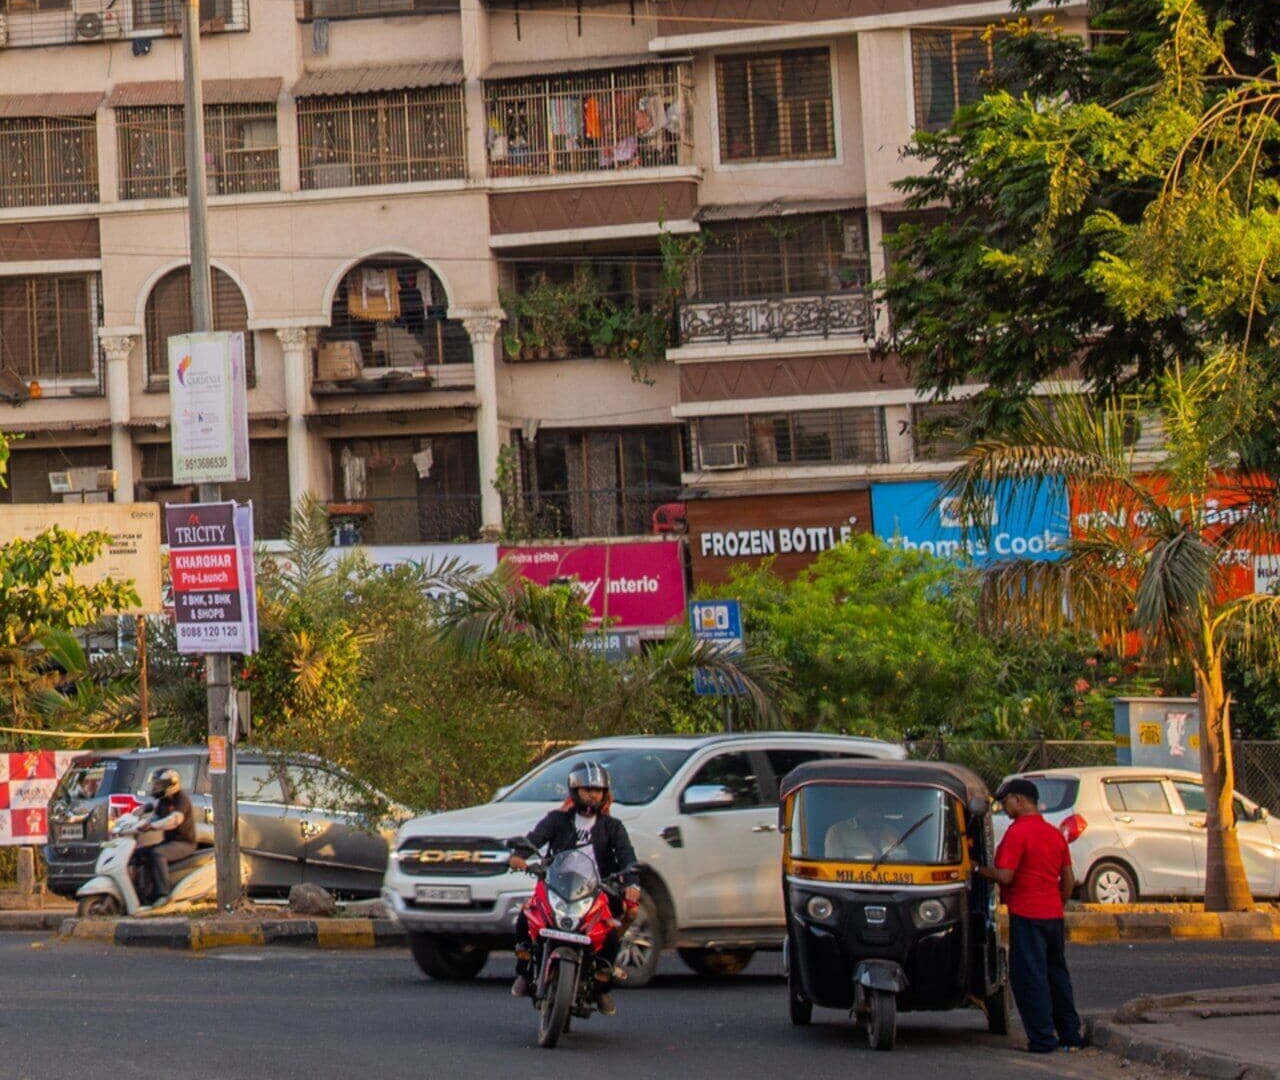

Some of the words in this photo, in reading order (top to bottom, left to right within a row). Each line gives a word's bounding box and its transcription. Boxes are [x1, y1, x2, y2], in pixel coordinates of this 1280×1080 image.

[175, 525, 226, 544] TRICITY
[701, 529, 776, 557] FROZEN
[994, 529, 1058, 555] Cook
[175, 554, 232, 569] KHARGHAR
[181, 571, 229, 584] Pre-Launch
[182, 595, 187, 606] 2
[188, 594, 208, 607] BHK,
[208, 594, 213, 605] 3
[214, 593, 231, 605] BHK
[190, 609, 196, 620] &
[197, 608, 225, 620] SHOPS
[181, 627, 202, 638] 8088
[204, 626, 219, 637] 120
[222, 626, 238, 637] 120
[396, 849, 511, 863] FORD
